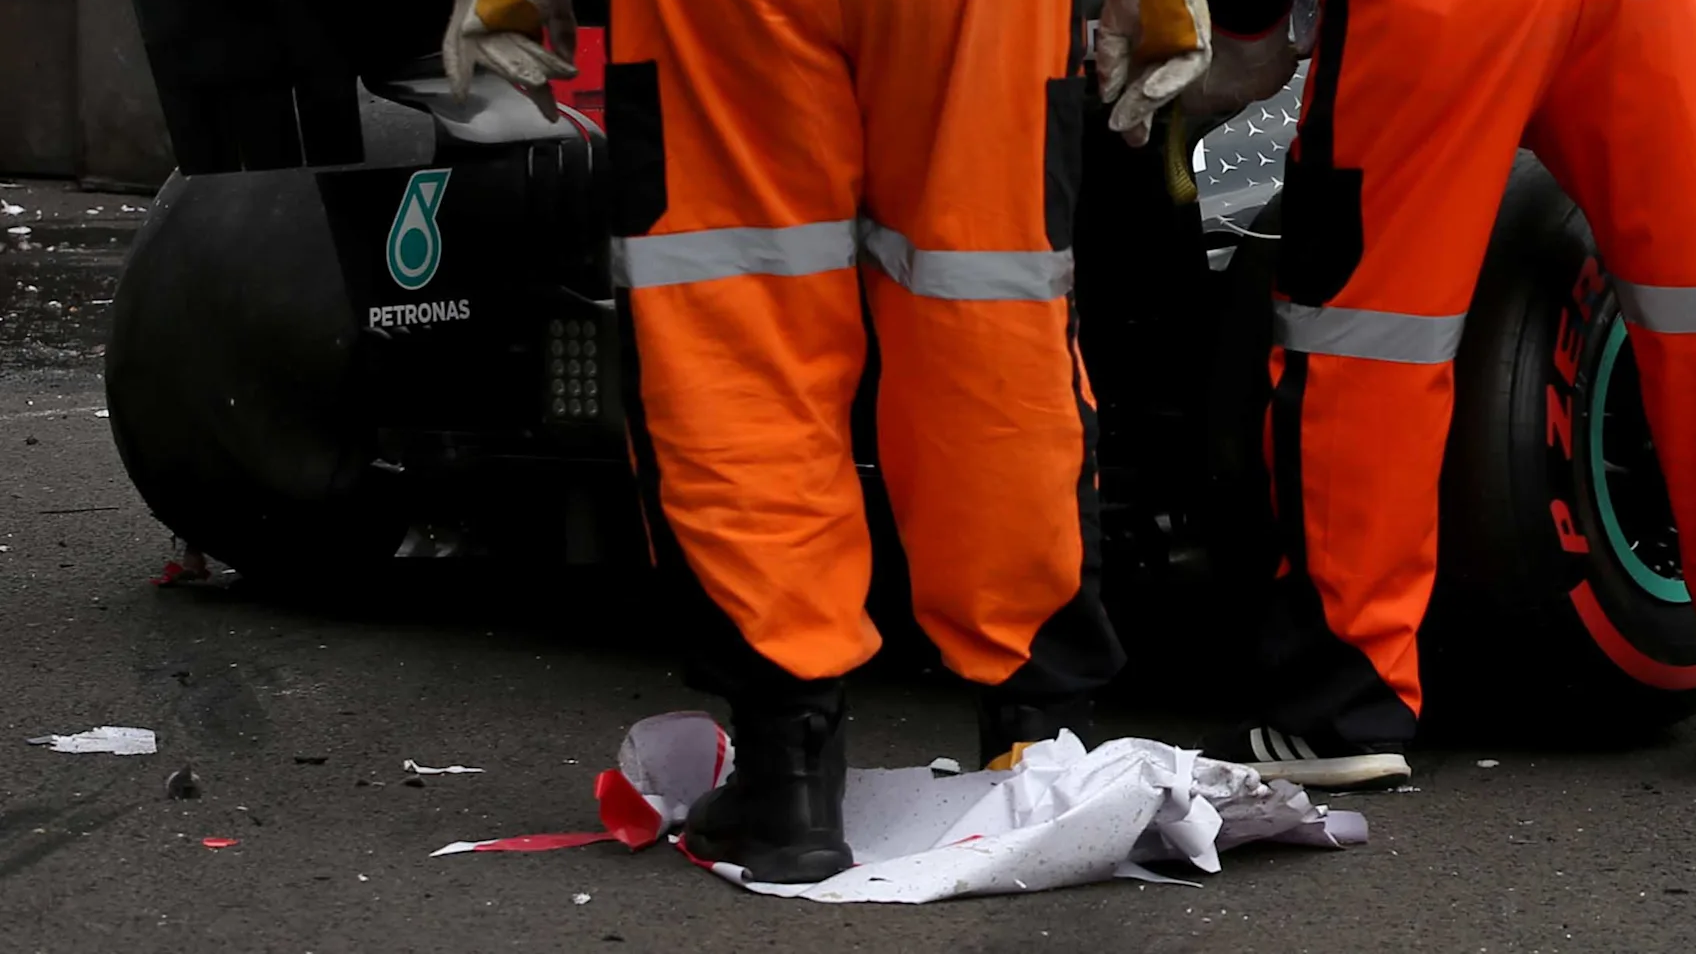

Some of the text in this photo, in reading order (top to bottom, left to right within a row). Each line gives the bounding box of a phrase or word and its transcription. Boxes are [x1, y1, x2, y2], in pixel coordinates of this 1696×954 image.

[368, 299, 471, 329] PETRONAS
[1546, 256, 1606, 554] P ZER
